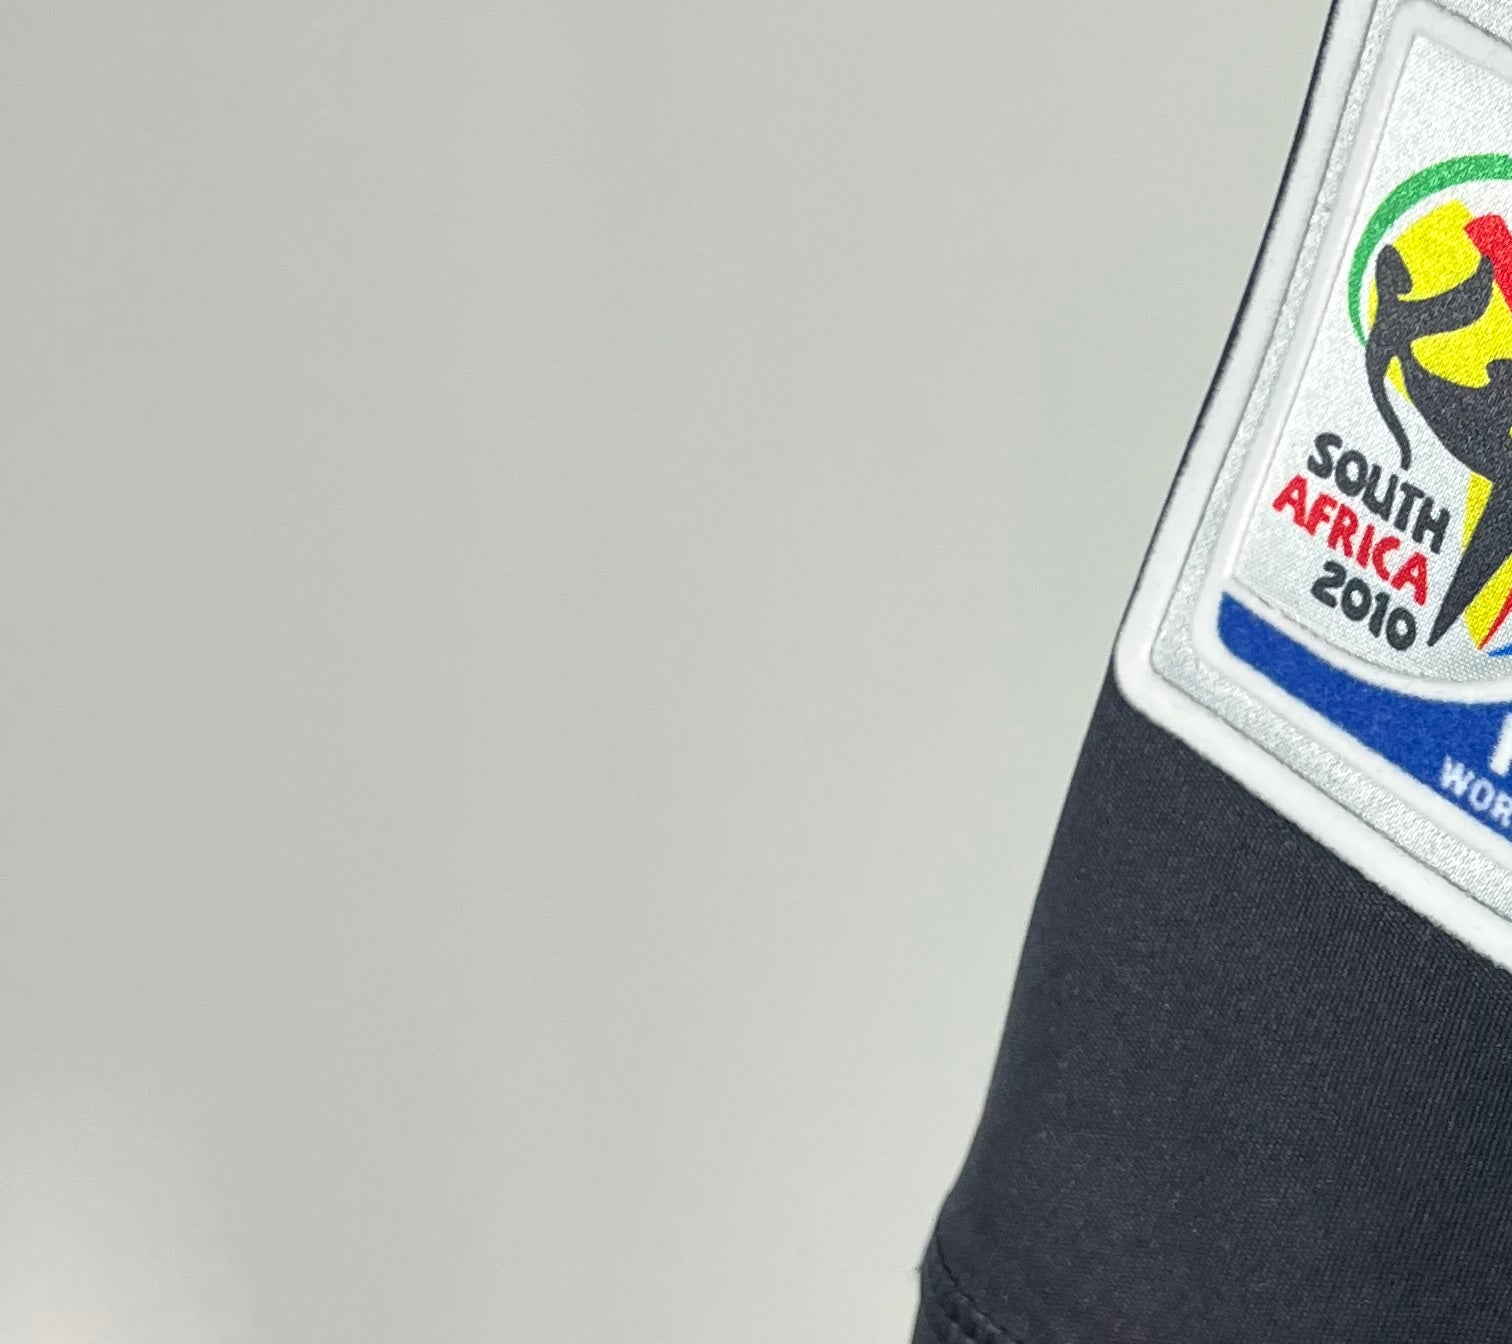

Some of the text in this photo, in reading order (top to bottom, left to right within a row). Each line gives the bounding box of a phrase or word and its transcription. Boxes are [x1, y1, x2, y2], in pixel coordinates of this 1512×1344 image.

[1272, 474, 1428, 606] AFRICA
[1306, 432, 1450, 554] SOUTH
[1310, 560, 1417, 651] 2010
